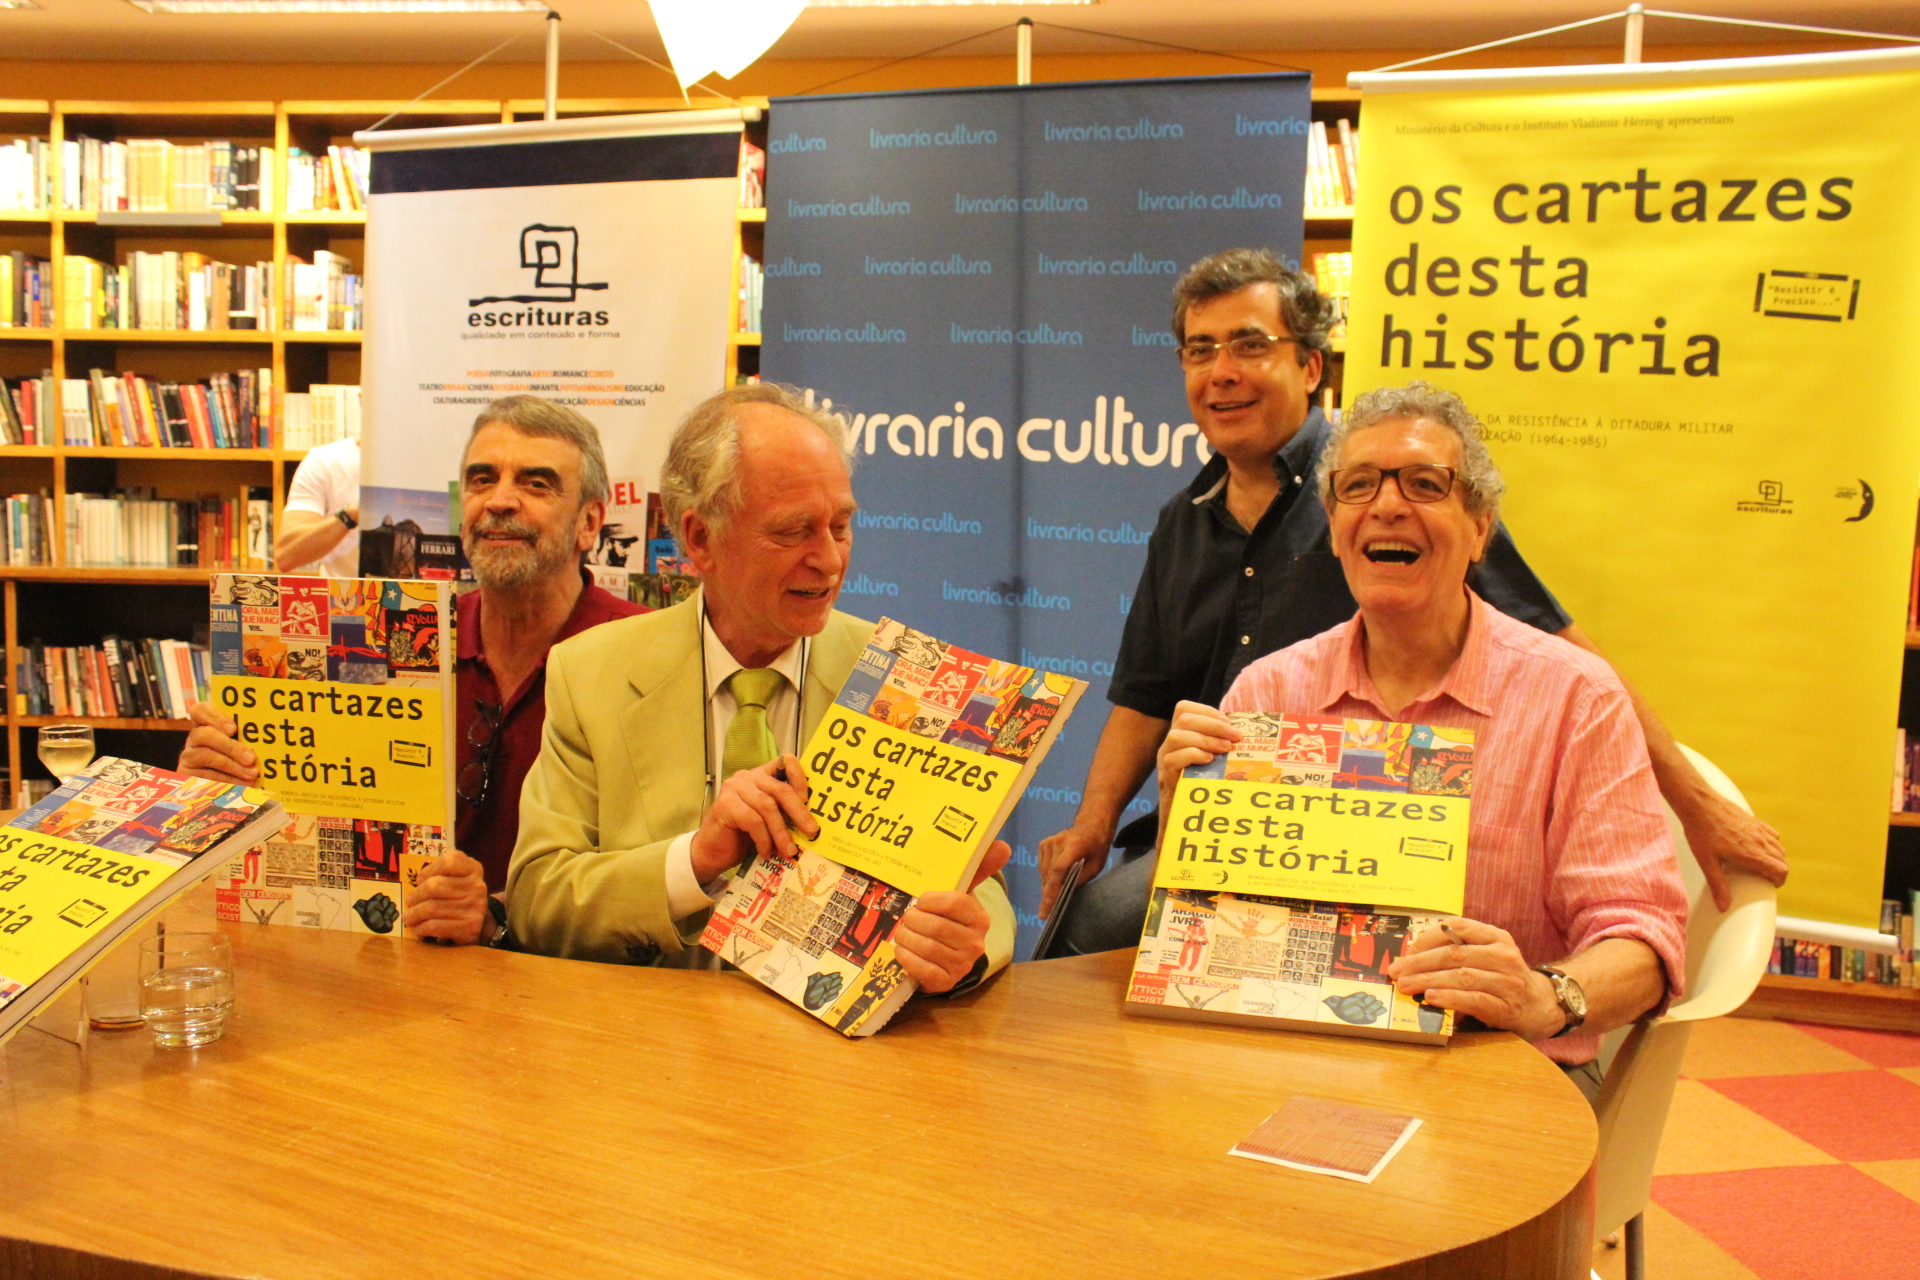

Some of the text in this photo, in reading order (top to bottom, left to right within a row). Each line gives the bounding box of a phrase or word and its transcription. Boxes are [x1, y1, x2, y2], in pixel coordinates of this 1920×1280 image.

[869, 123, 998, 148] livraria cultura
[1044, 117, 1184, 141] livraria cultura
[1235, 114, 1309, 136] livraria
[1395, 114, 1734, 136] Ministério da Cultura e o Instituto Vladimir Herzog apresentam
[769, 132, 827, 153] cultura
[788, 195, 911, 217] livraria cultura
[955, 190, 1088, 213] livraria cultura
[1138, 186, 1282, 211] livraria cultura
[1388, 168, 1855, 225] os cartazes
[764, 256, 822, 277] cultura
[865, 253, 993, 275] livraria cultura
[1038, 252, 1178, 275] livraria cultura
[1384, 242, 1589, 298] desta
[467, 307, 609, 327] escrituras
[460, 330, 506, 340] qualidade
[527, 330, 575, 339] conteúdo
[588, 330, 620, 339] forma
[783, 321, 906, 343] livraria cultura
[951, 322, 1083, 345] livraria cultura
[1132, 325, 1179, 346] livra
[1380, 313, 1722, 377] história
[1487, 414, 1502, 425] DA
[1509, 413, 1588, 429] RESISTÊNCIA
[1611, 419, 1671, 432] DITADURA
[1679, 422, 1734, 434] MILITAR
[1530, 433, 1608, 448] (1964-1985)
[608, 482, 642, 506] EL
[856, 508, 982, 535] livraria cultura
[1736, 505, 1794, 515] escrituras
[1027, 516, 1152, 545] livraria cultur
[420, 544, 456, 555] FERRARI
[942, 580, 1071, 610] livraria cultura
[305, 647, 321, 659] NO!
[1021, 648, 1088, 674] livraria
[221, 685, 423, 720] os cartazes
[931, 716, 947, 730] NO!
[828, 718, 999, 792] os cartazes
[258, 753, 377, 789] stória
[811, 747, 895, 801] desta
[1304, 773, 1325, 784] NO!
[1189, 786, 1448, 823] os cartazes
[808, 786, 914, 849] istória
[1183, 810, 1305, 841] desta
[18, 843, 151, 888] cartazes
[759, 859, 782, 877] IVRE
[1177, 838, 1379, 877] história
[241, 889, 256, 898] SEM
[1169, 915, 1201, 928] IVRE
[1170, 975, 1190, 984] SEM
